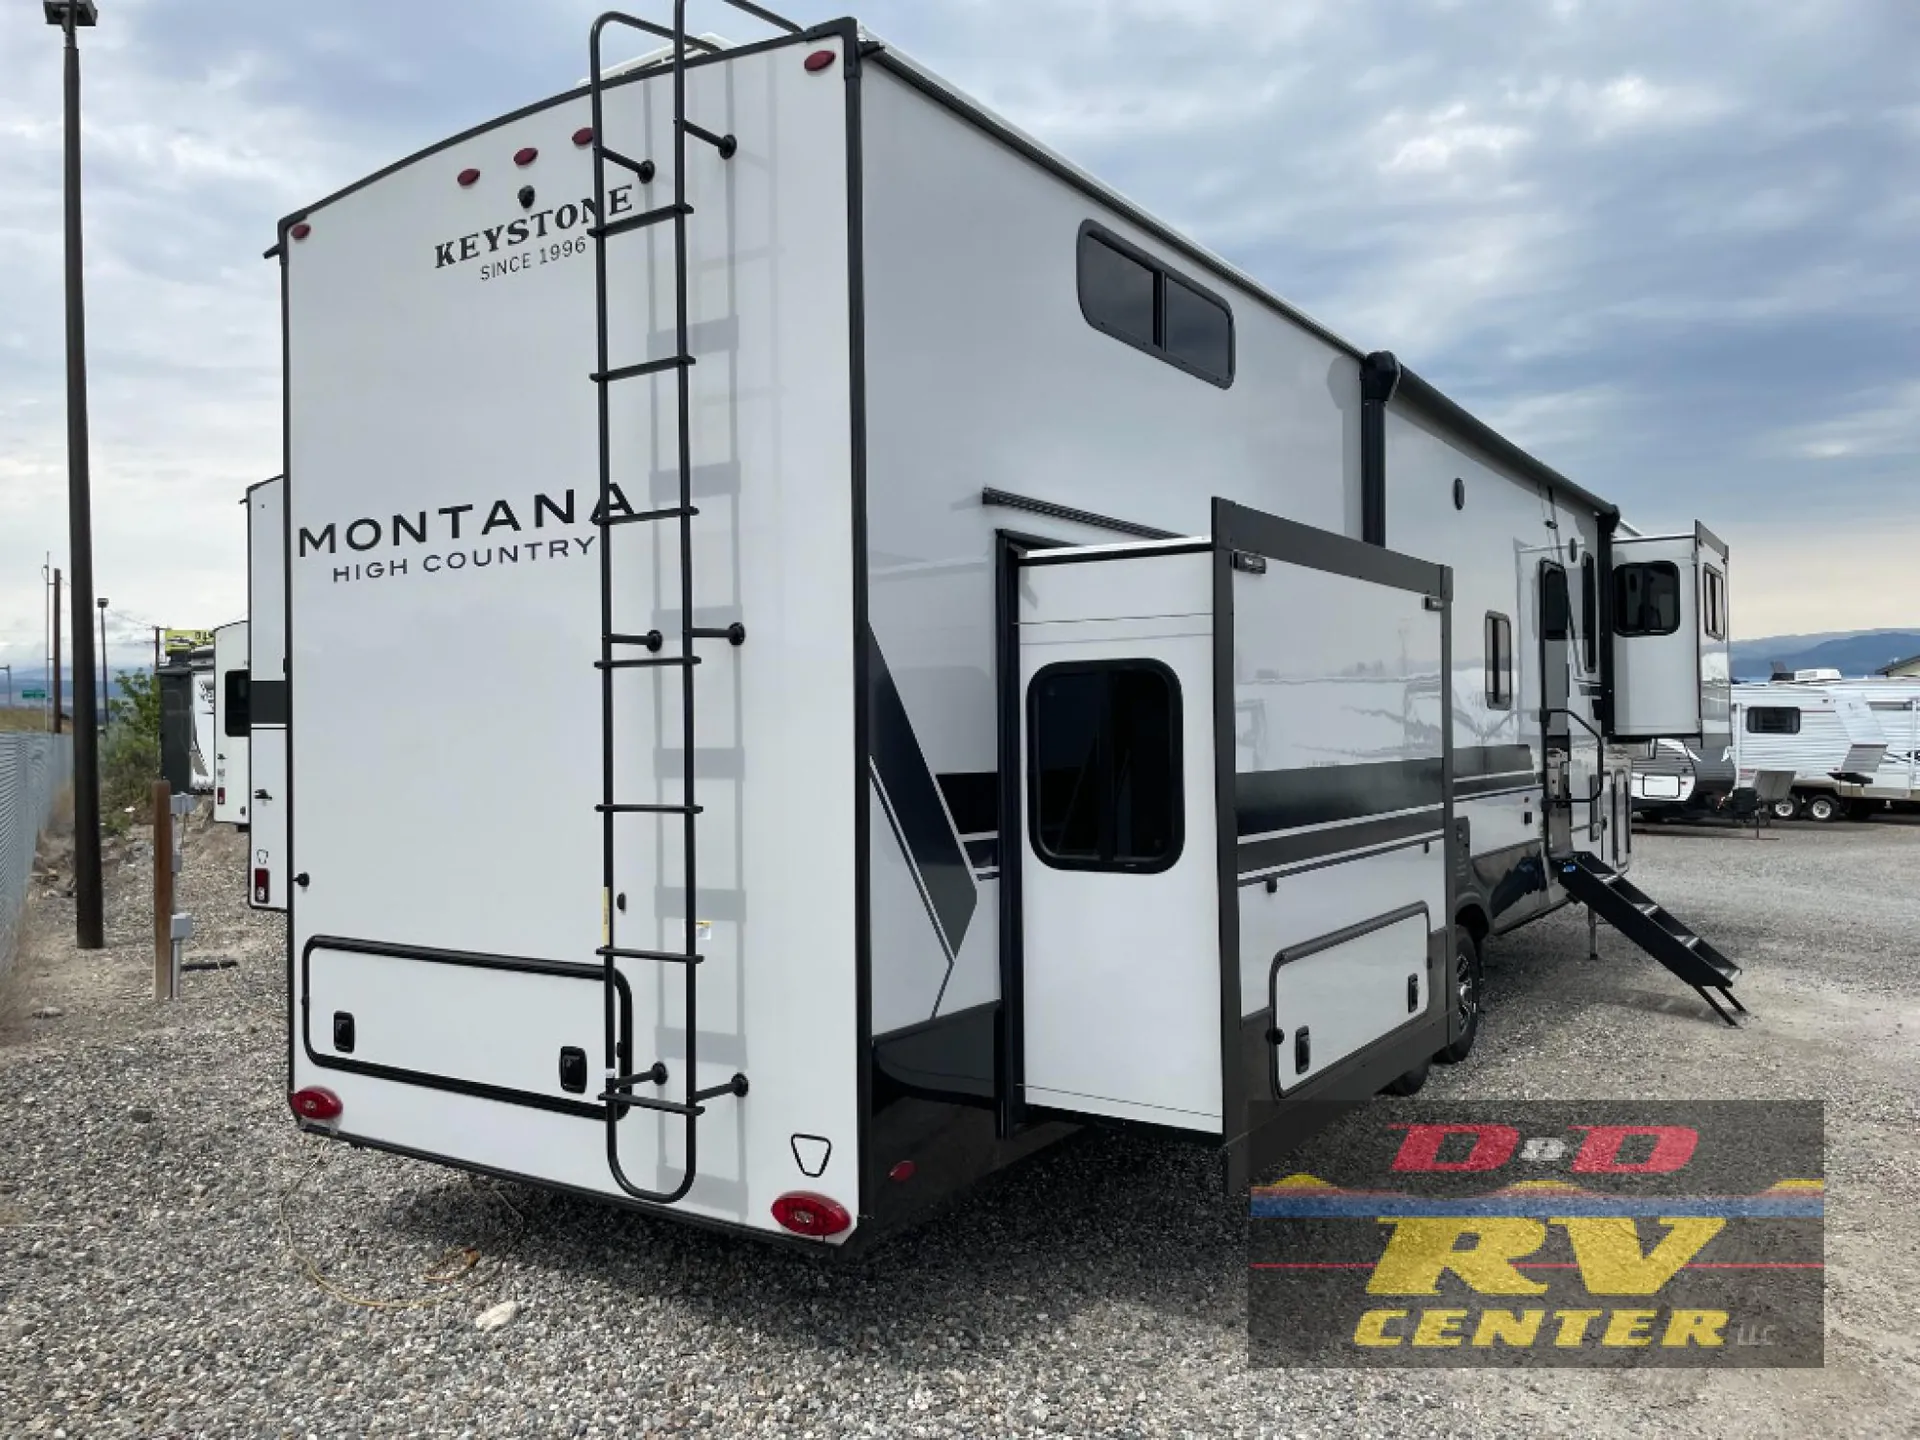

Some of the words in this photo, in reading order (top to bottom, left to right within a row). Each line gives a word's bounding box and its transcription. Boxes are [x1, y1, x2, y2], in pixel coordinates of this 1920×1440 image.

[434, 184, 633, 269] KEYSTONE
[479, 252, 532, 282] SINCE
[539, 236, 587, 265] 1996
[299, 482, 636, 558] MONTANA
[333, 558, 408, 583] HIGH
[423, 536, 596, 573] COUNTRY
